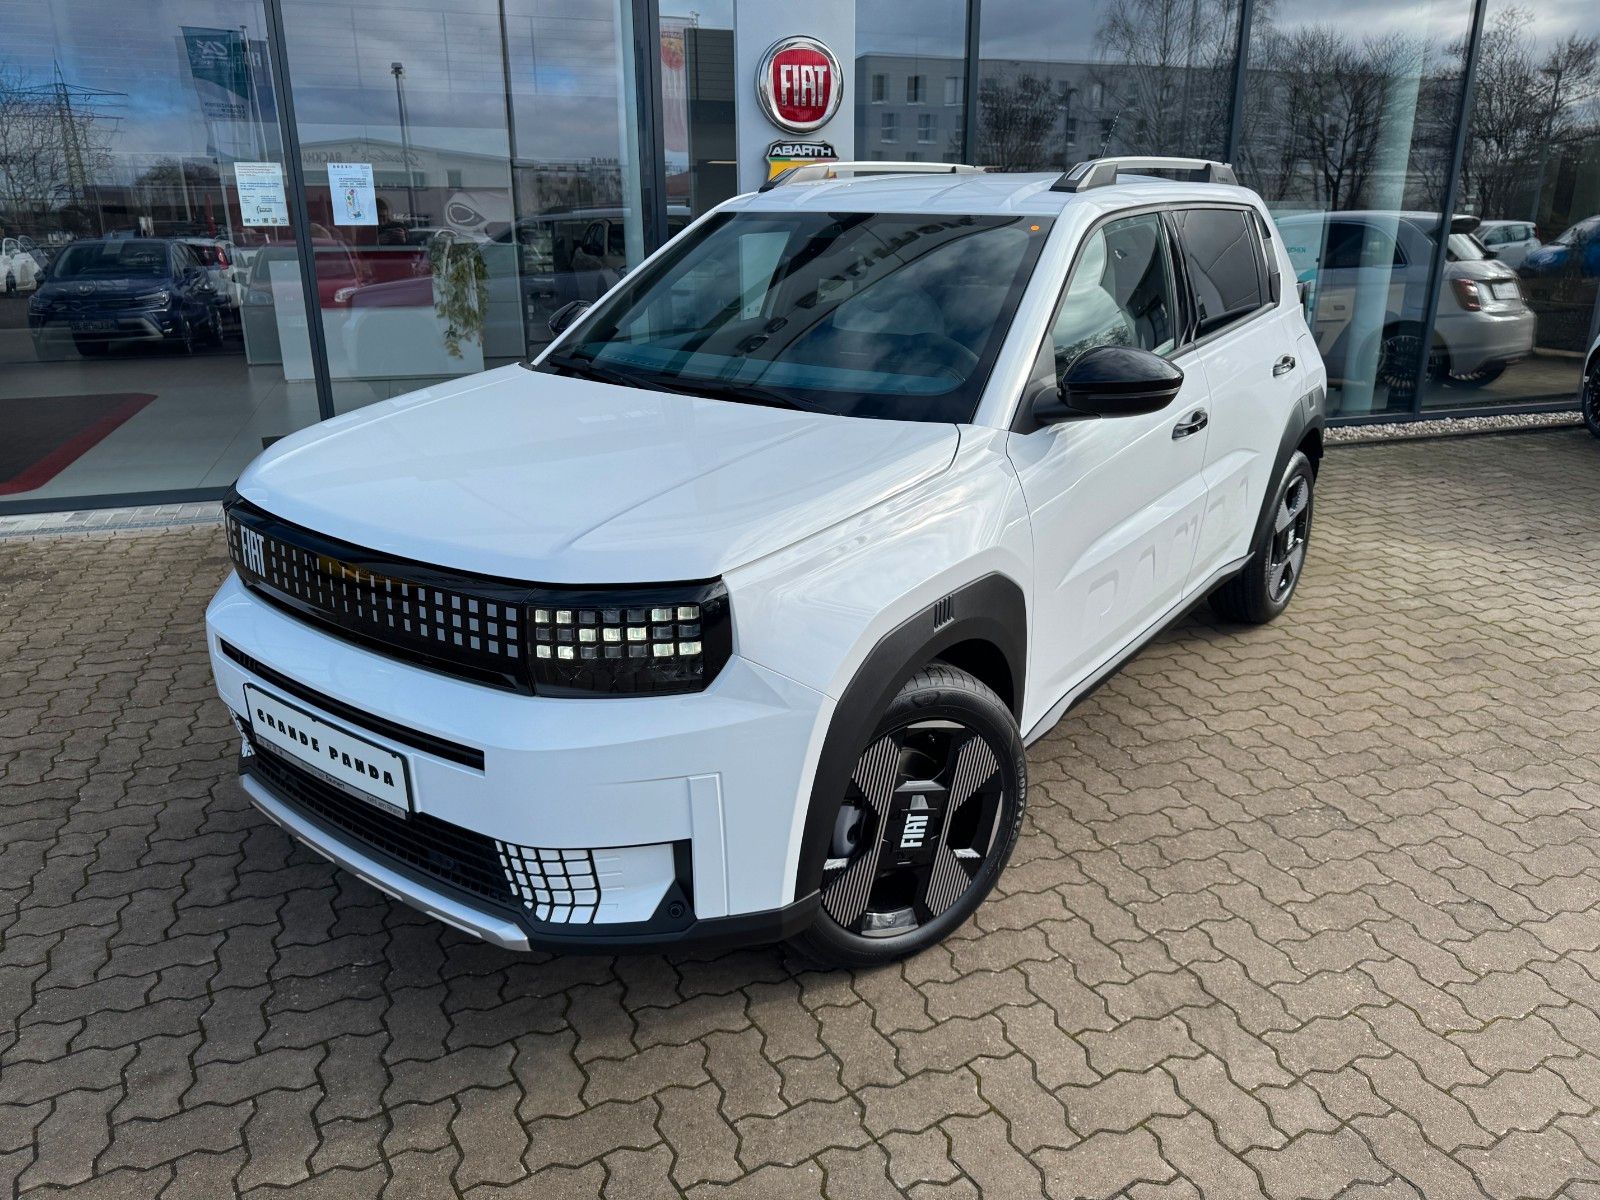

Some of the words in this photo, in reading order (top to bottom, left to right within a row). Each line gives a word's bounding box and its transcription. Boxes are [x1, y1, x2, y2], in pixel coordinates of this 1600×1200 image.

[780, 64, 827, 107] FIAT
[772, 144, 832, 156] ABARTH
[240, 524, 266, 577] FIAT
[256, 708, 320, 752] GRANDE
[328, 745, 395, 787] PANDA
[900, 813, 929, 848] FIAT
